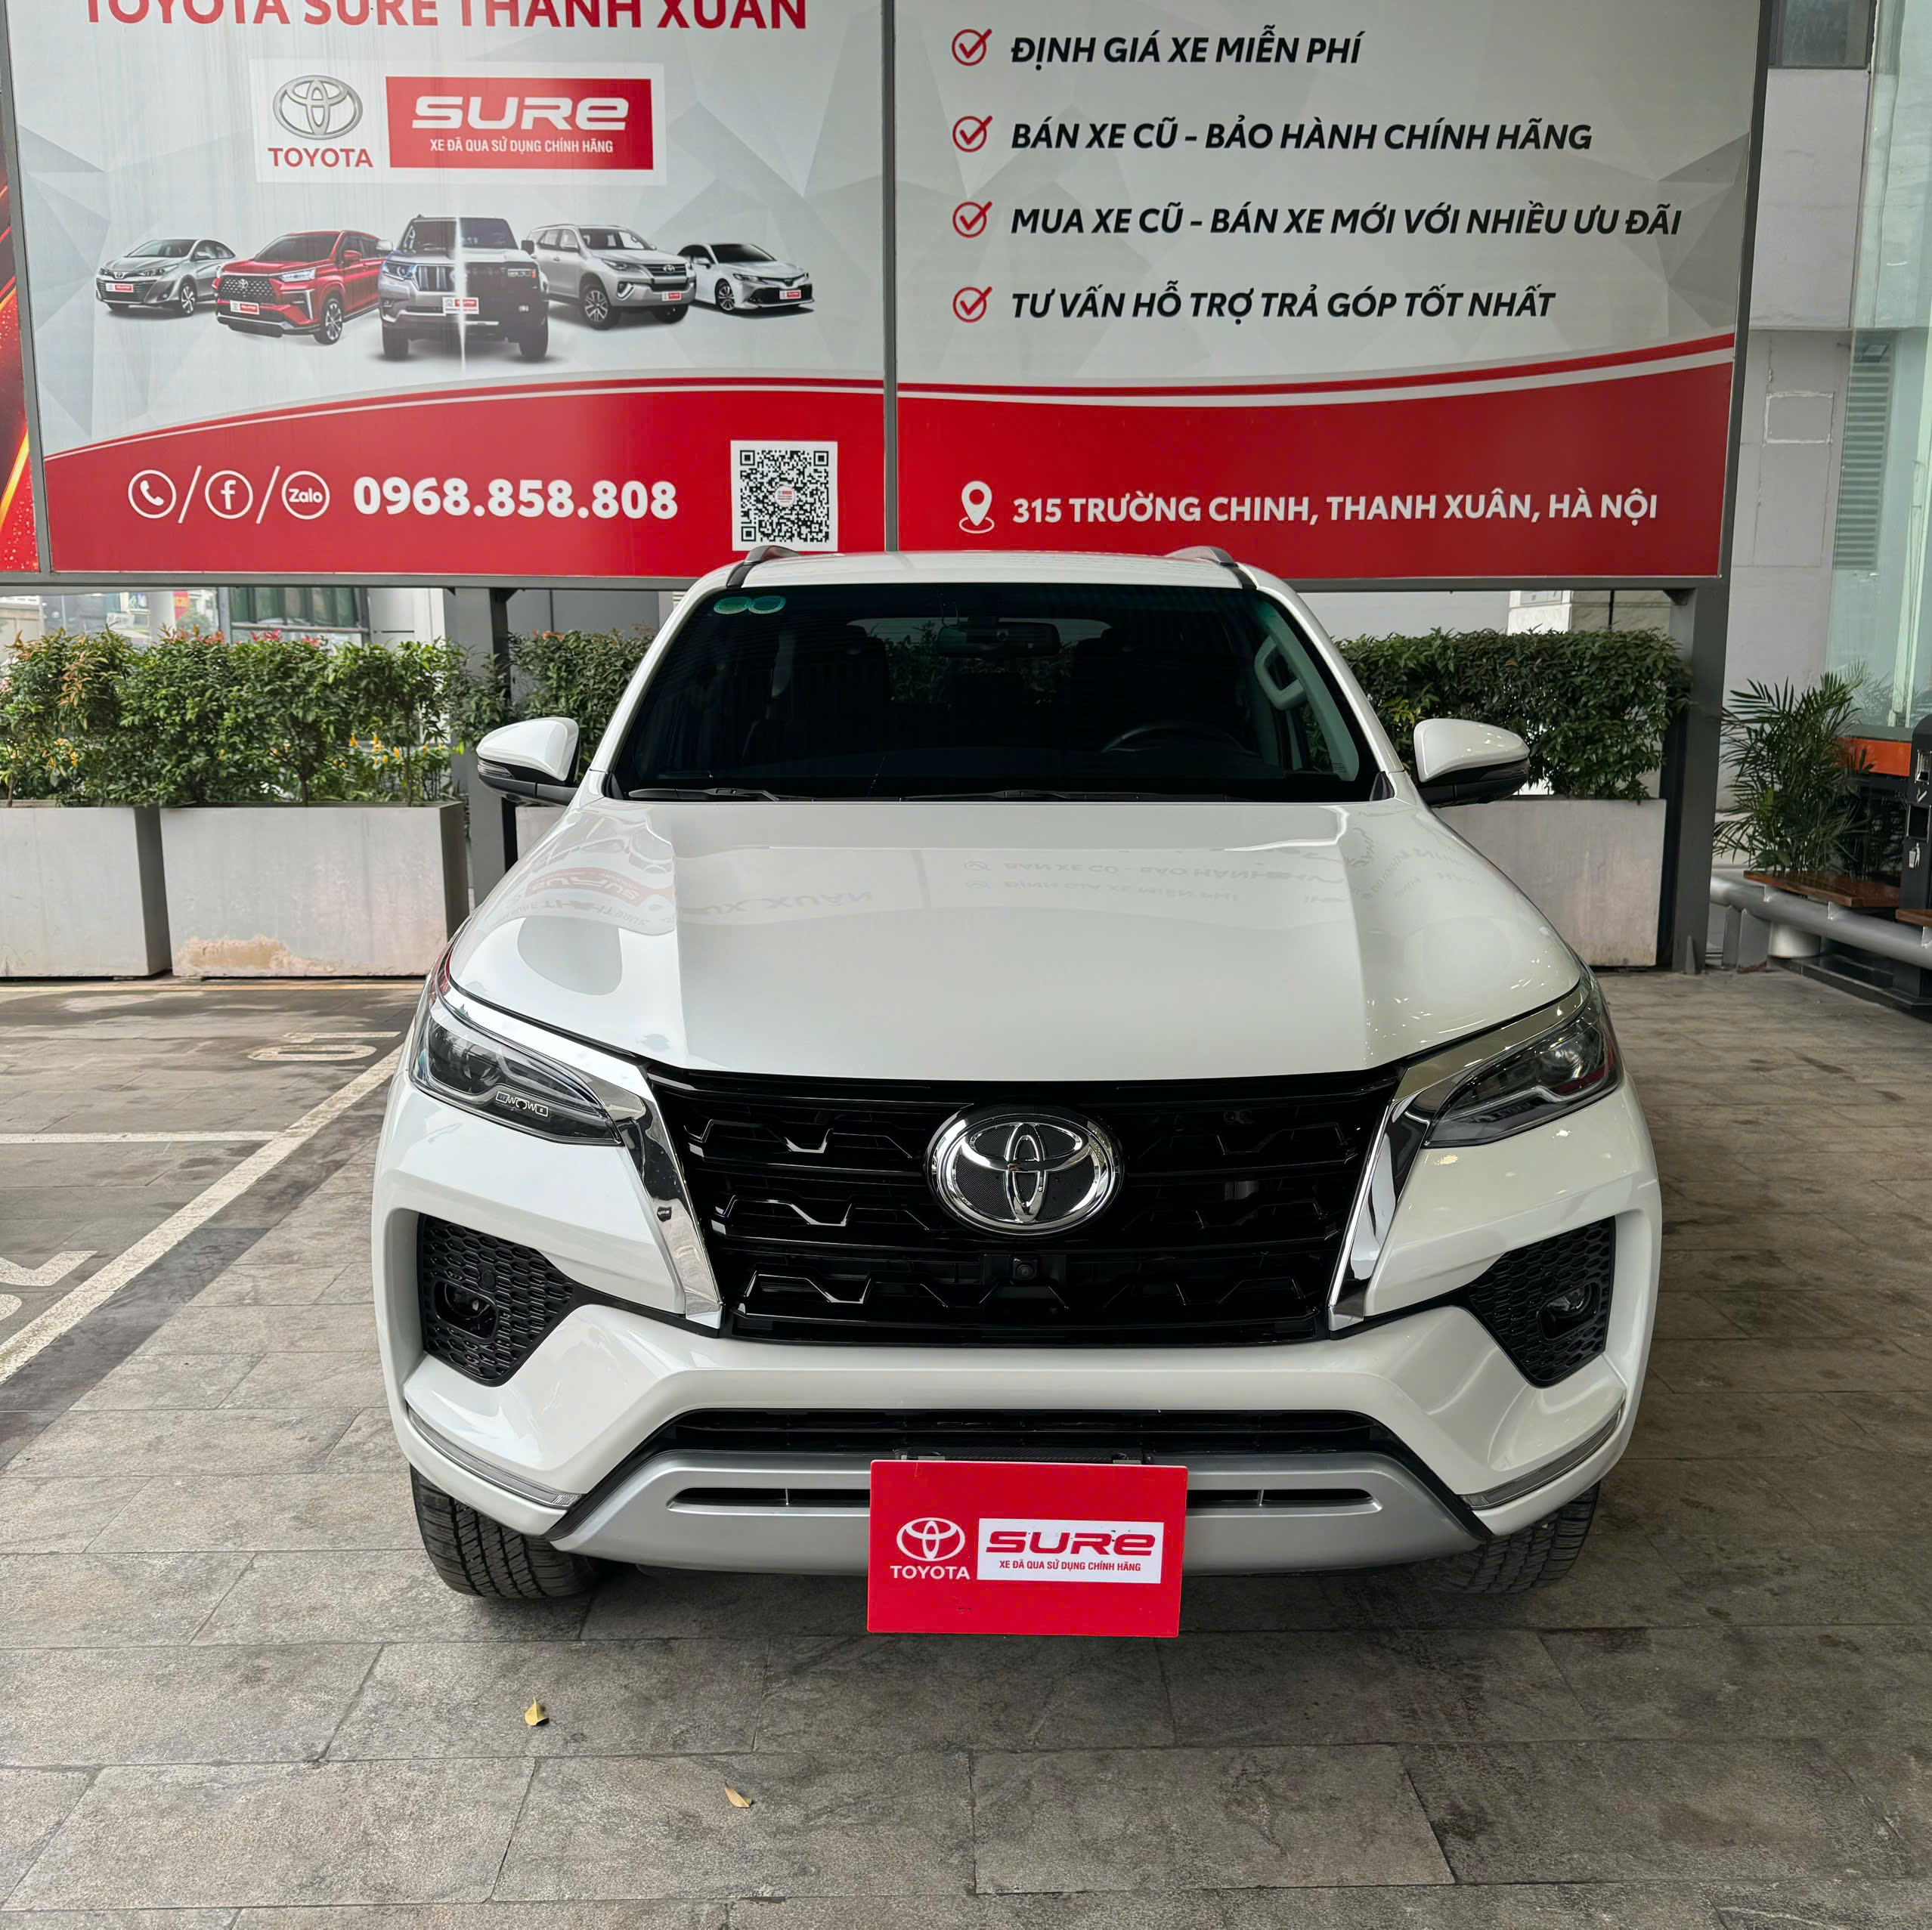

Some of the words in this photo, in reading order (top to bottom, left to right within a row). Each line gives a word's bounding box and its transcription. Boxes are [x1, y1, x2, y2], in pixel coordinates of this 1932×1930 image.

[305, 0, 438, 26] SURE
[1011, 38, 1096, 70] ĐỊNH
[1104, 30, 1160, 62] GIÁ
[1168, 37, 1209, 62] XE
[1215, 25, 1299, 63] MIỄN
[1307, 31, 1365, 63] PHÍ
[430, 139, 444, 151] XE
[447, 137, 463, 151] ĐÃ
[466, 139, 489, 152] QUA
[491, 136, 507, 152] SỬ
[510, 140, 541, 154] DỤNG
[545, 138, 579, 152] CHÍNH
[583, 139, 612, 152] HÃNG
[1012, 116, 1079, 148] BÁN
[1085, 124, 1126, 148] XE
[1134, 117, 1178, 148] CŨ
[1206, 115, 1273, 148] BẢO
[1280, 117, 1377, 149] HÀNH
[1385, 117, 1490, 149] CHÍNH
[1497, 118, 1592, 150] HÃNG
[269, 148, 373, 167] TOYOTA
[1011, 209, 1083, 234] MUA
[1091, 209, 1132, 233] XE
[1140, 202, 1183, 233] CŨ
[1211, 202, 1278, 233] BÁN
[1283, 209, 1324, 233] XE
[1331, 203, 1395, 234] MỚI
[1405, 203, 1460, 234] VỚI
[1466, 200, 1567, 234] NHIỀU
[1574, 205, 1619, 234] ƯU
[1625, 203, 1682, 234] ĐÃI
[1013, 289, 1055, 317] TƯ
[1060, 284, 1125, 317] VẤN
[1133, 280, 1181, 317] HỖ
[1190, 288, 1254, 324] TRỢ
[1262, 284, 1317, 317] TRẢ
[1328, 286, 1396, 317] GÓP
[1405, 284, 1463, 317] TỐT
[1469, 284, 1556, 316] NHẤT
[289, 487, 324, 504] Zalo
[354, 477, 677, 518] 0968.858.808
[1013, 499, 1061, 522] 315
[1070, 491, 1200, 522] TRƯỜNG
[1209, 497, 1317, 524] CHINH,
[1327, 495, 1435, 520] THANH
[1444, 488, 1540, 522] XUÂN,
[1550, 488, 1592, 518] HÀ
[1601, 488, 1657, 525] NỘI
[890, 1566, 970, 1579] TOYOTA
[999, 1560, 1011, 1570] XE
[1012, 1558, 1025, 1570] ĐÃ
[1026, 1561, 1045, 1570] QUA
[1047, 1558, 1060, 1570] SỬ
[1060, 1561, 1086, 1573] DỤNG
[1088, 1560, 1115, 1571] CHÍNH
[1117, 1561, 1141, 1572] HÃNG
